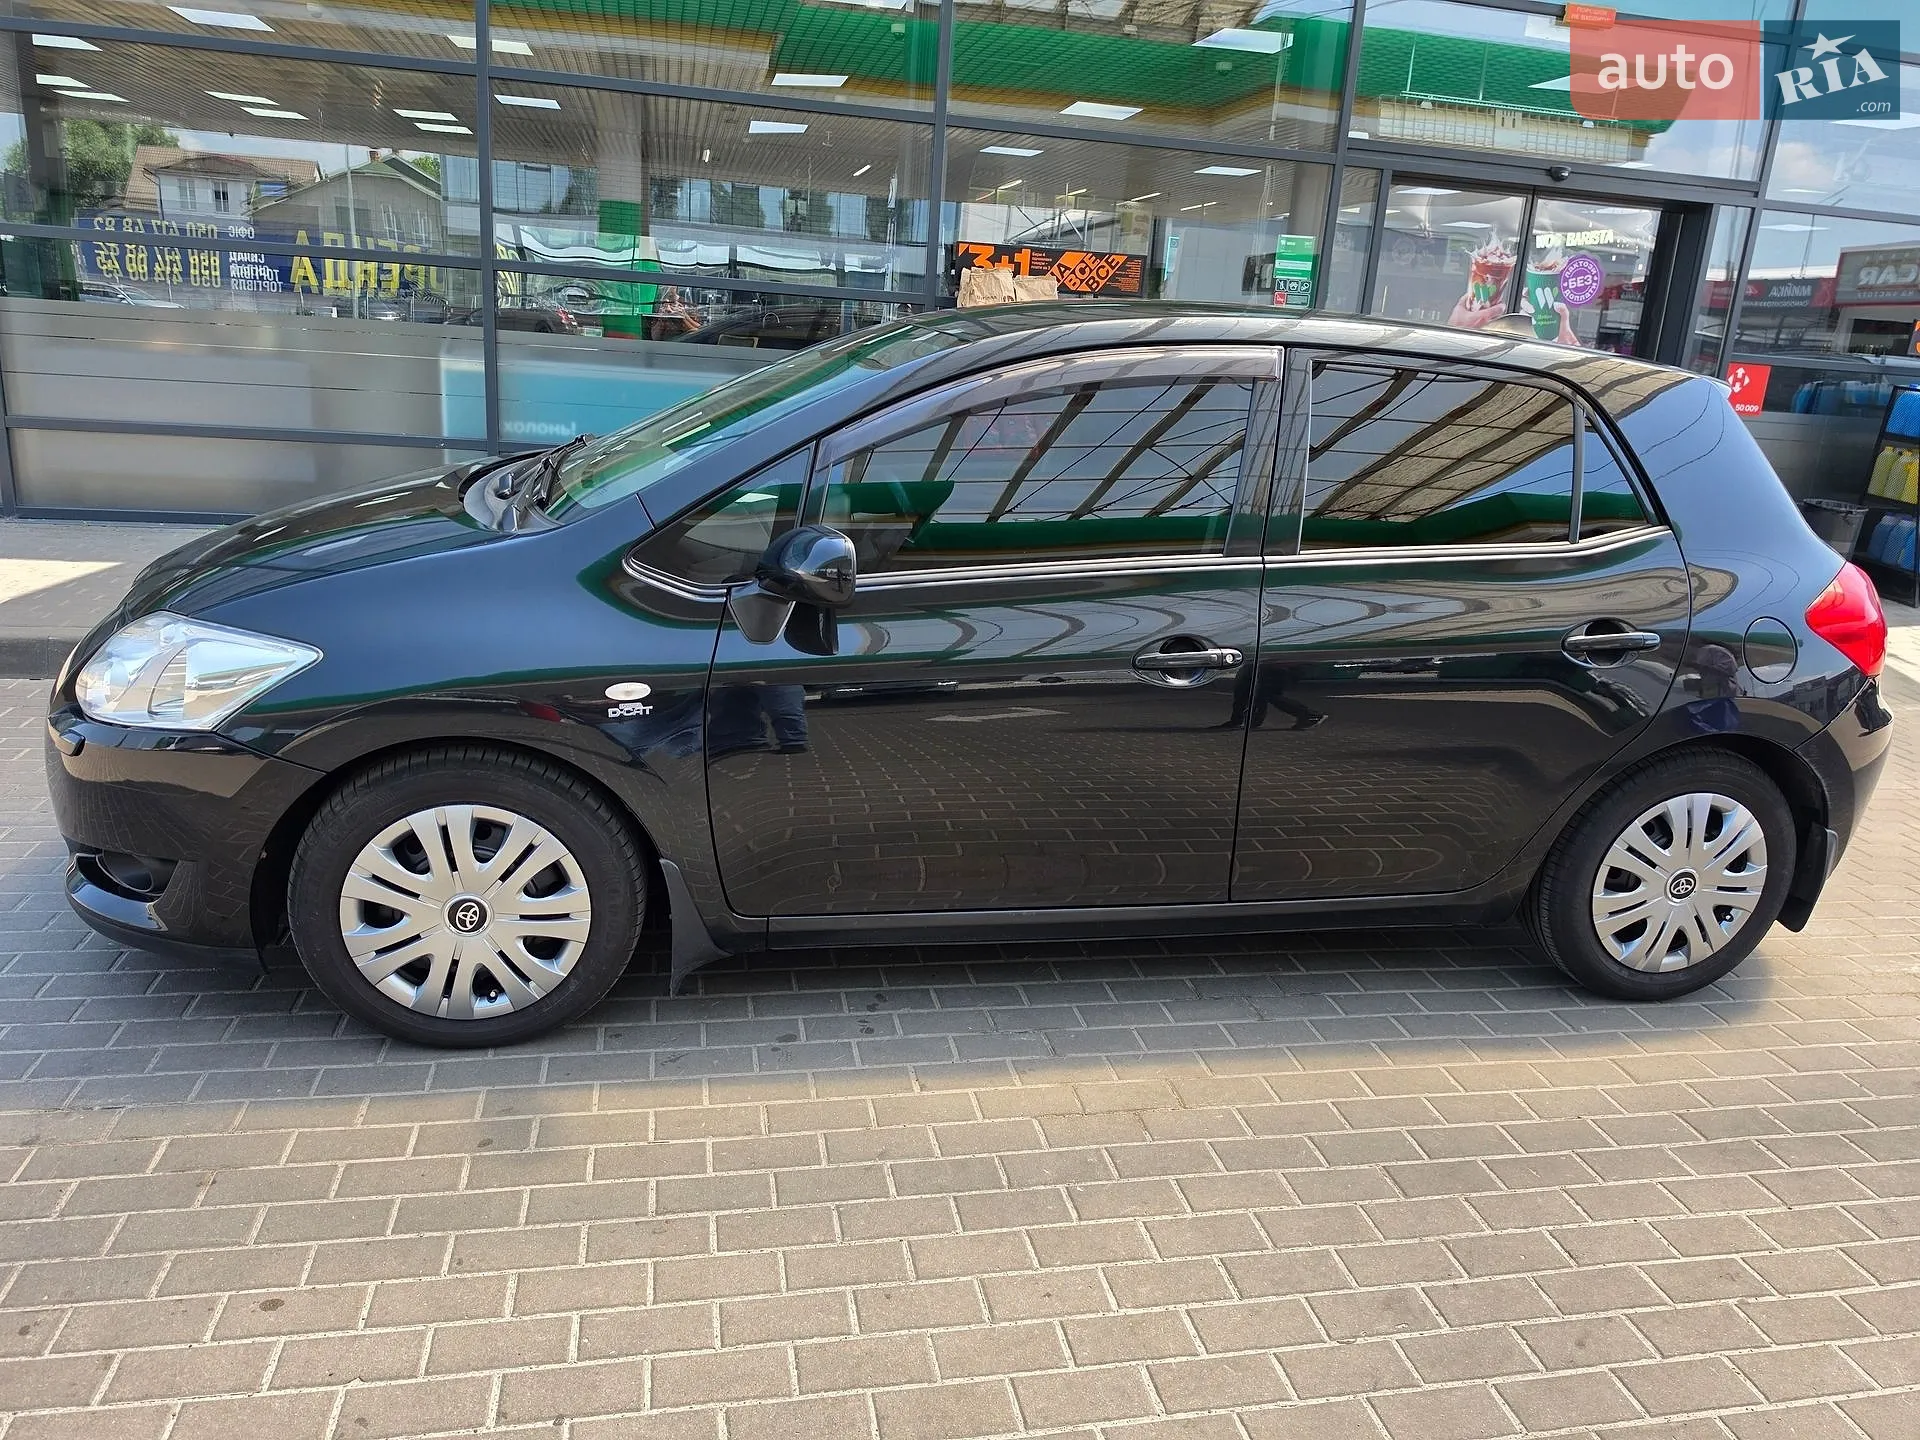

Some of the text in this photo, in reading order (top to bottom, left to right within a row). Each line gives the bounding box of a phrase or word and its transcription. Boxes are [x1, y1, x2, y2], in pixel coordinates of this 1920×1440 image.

[1566, 230, 1613, 246] BARISTA
[1063, 253, 1100, 291] ВСЕ
[1084, 255, 1121, 292] ВСЕ
[1568, 275, 1593, 289] БЕЗ
[608, 706, 653, 718] D-CAT
